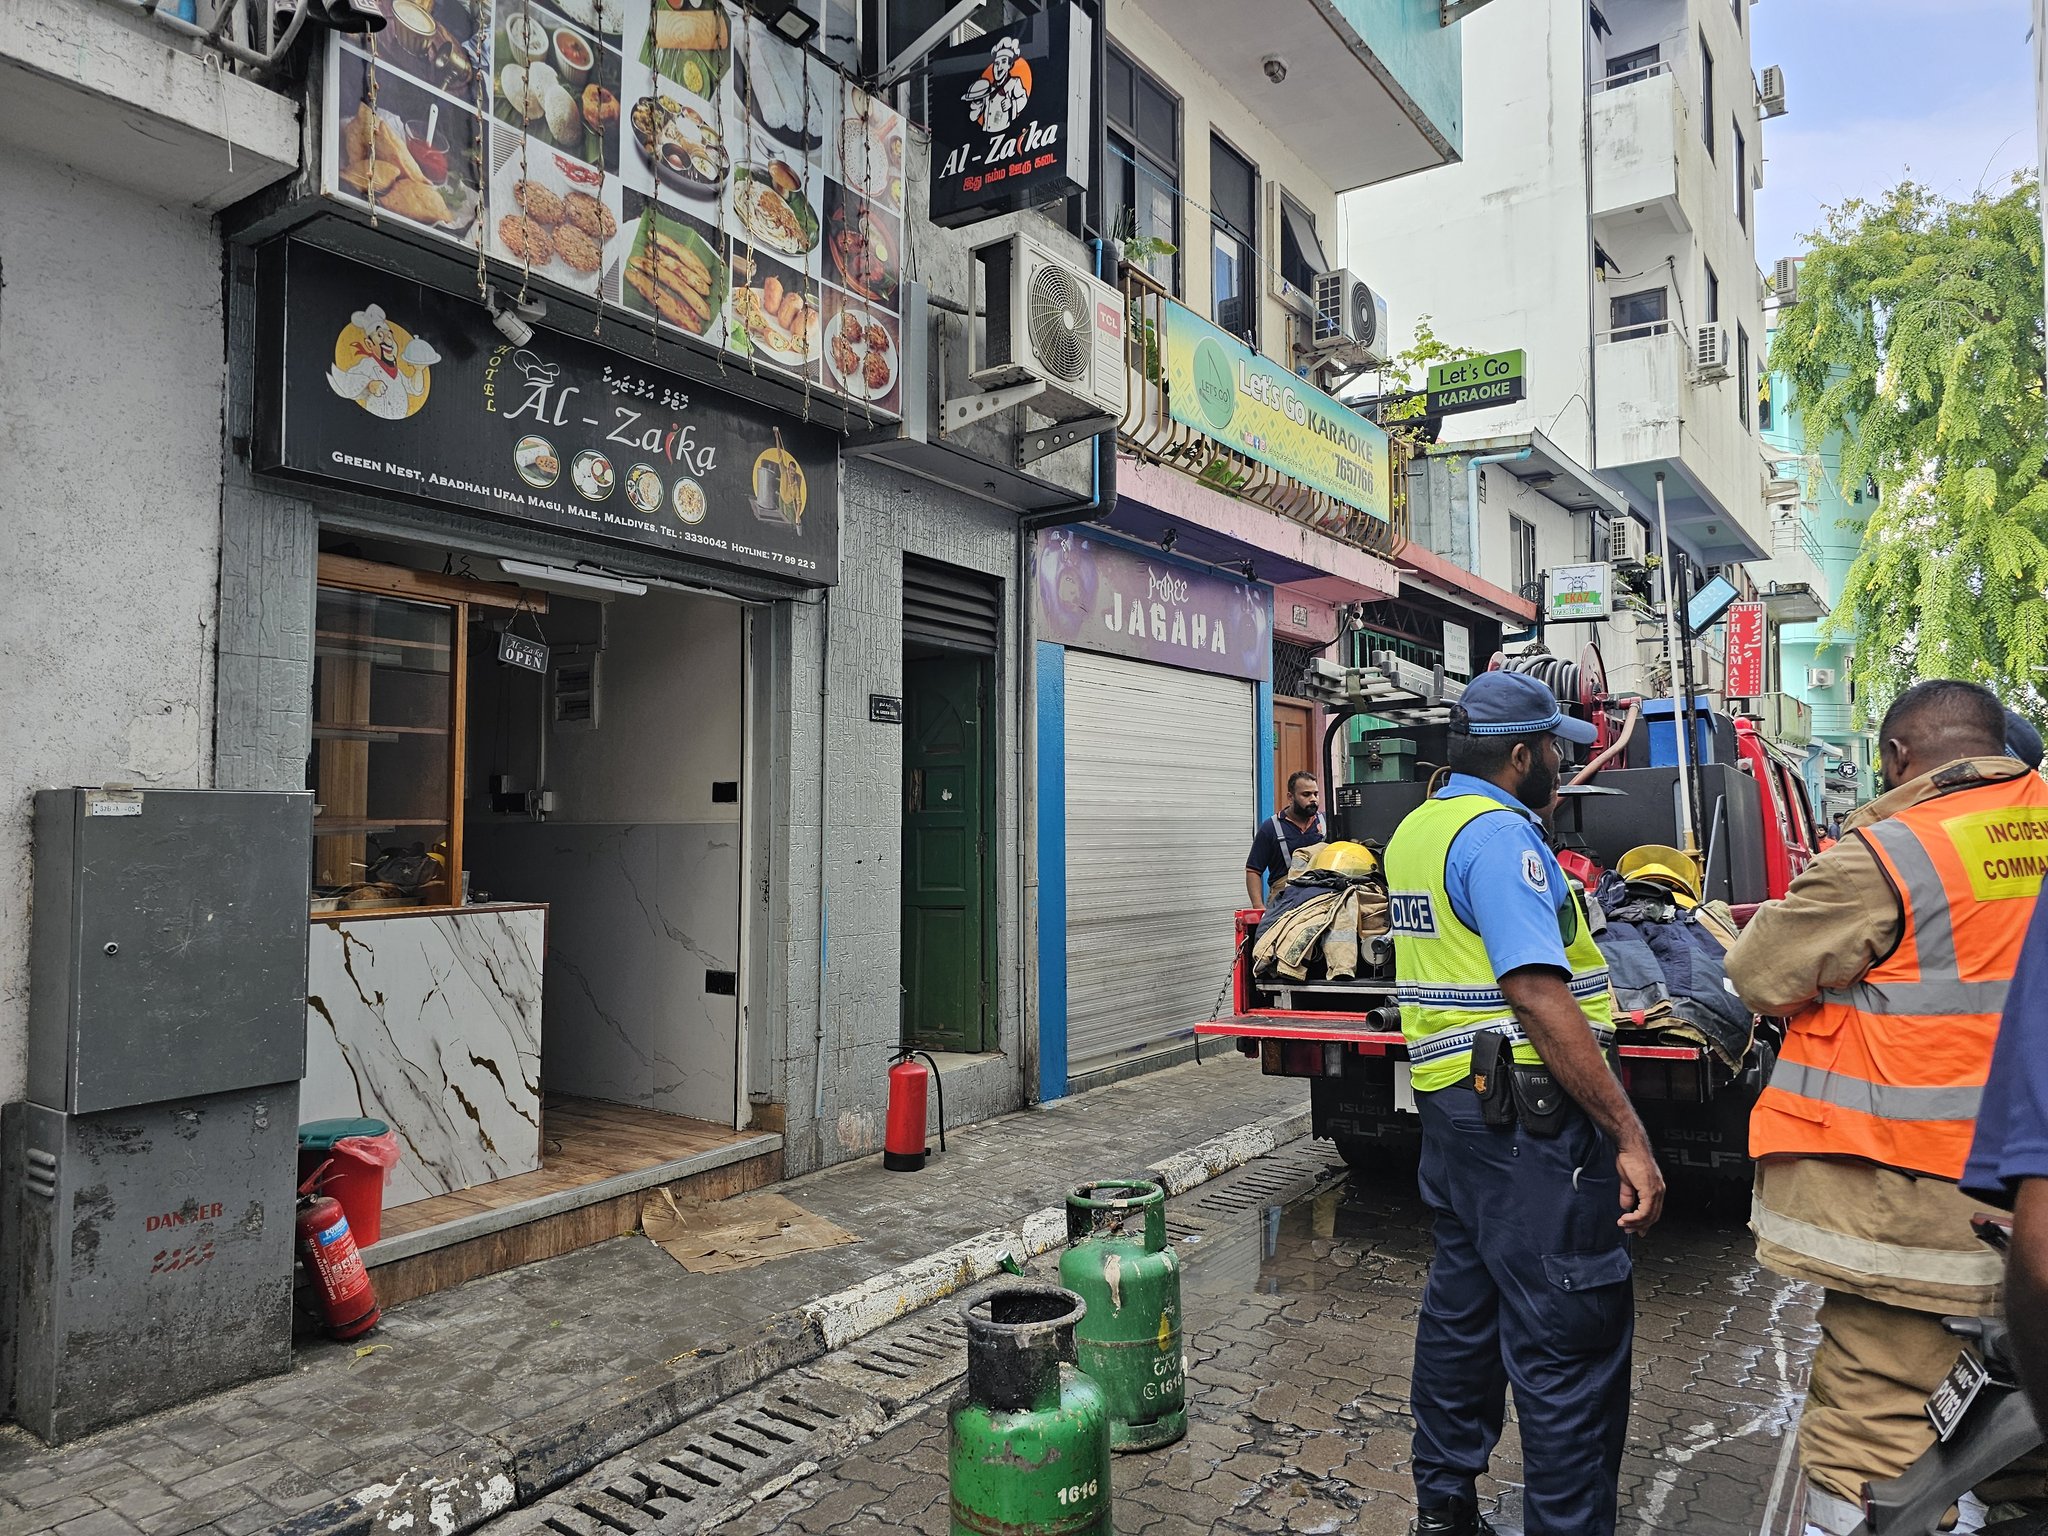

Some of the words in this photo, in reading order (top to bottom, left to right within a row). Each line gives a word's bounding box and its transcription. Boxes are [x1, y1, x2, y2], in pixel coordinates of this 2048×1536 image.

[938, 143, 971, 179] Al
[984, 120, 1059, 165] Zaika
[963, 176, 982, 191] இது
[985, 168, 1006, 184] நம்ம
[1009, 160, 1031, 177] ஊரு
[1034, 153, 1058, 169] கடை
[1100, 311, 1118, 330] TCL
[483, 344, 515, 412] HOTEL
[1440, 364, 1479, 386] Let's
[1484, 359, 1510, 377] Go
[1438, 381, 1510, 407] KARAOKE
[1238, 358, 1281, 412] Let's
[1282, 386, 1306, 427] Go
[1307, 409, 1373, 465] KARAOKE
[502, 382, 580, 427] Al
[606, 406, 717, 477] Zaika
[332, 451, 381, 472] GREEN
[385, 463, 426, 483] NEST,
[428, 472, 490, 496] ABADHAH
[493, 488, 525, 504] UFAA
[527, 495, 565, 514] MAGU,
[567, 504, 602, 522] MALE,
[604, 512, 658, 533] MALDIVES.
[660, 525, 677, 538] TEL
[684, 532, 727, 550] 3330042
[731, 542, 770, 560] HOTLINE:
[771, 551, 783, 562] 77
[784, 555, 796, 565] 99
[797, 558, 809, 568] 22
[810, 561, 816, 570] 3
[1564, 591, 1590, 604] EKAZ
[1731, 604, 1761, 612] FAITH
[1104, 592, 1226, 655] JAGAHA
[505, 648, 541, 669] OPEN
[1729, 612, 1742, 697] PHARMACY
[1983, 856, 2048, 880] COMMA
[1339, 1102, 1387, 1116] ISUZU
[1663, 1128, 1722, 1143] ISUZU
[146, 1202, 223, 1232] DANER
[1057, 1478, 1098, 1505] 1616
